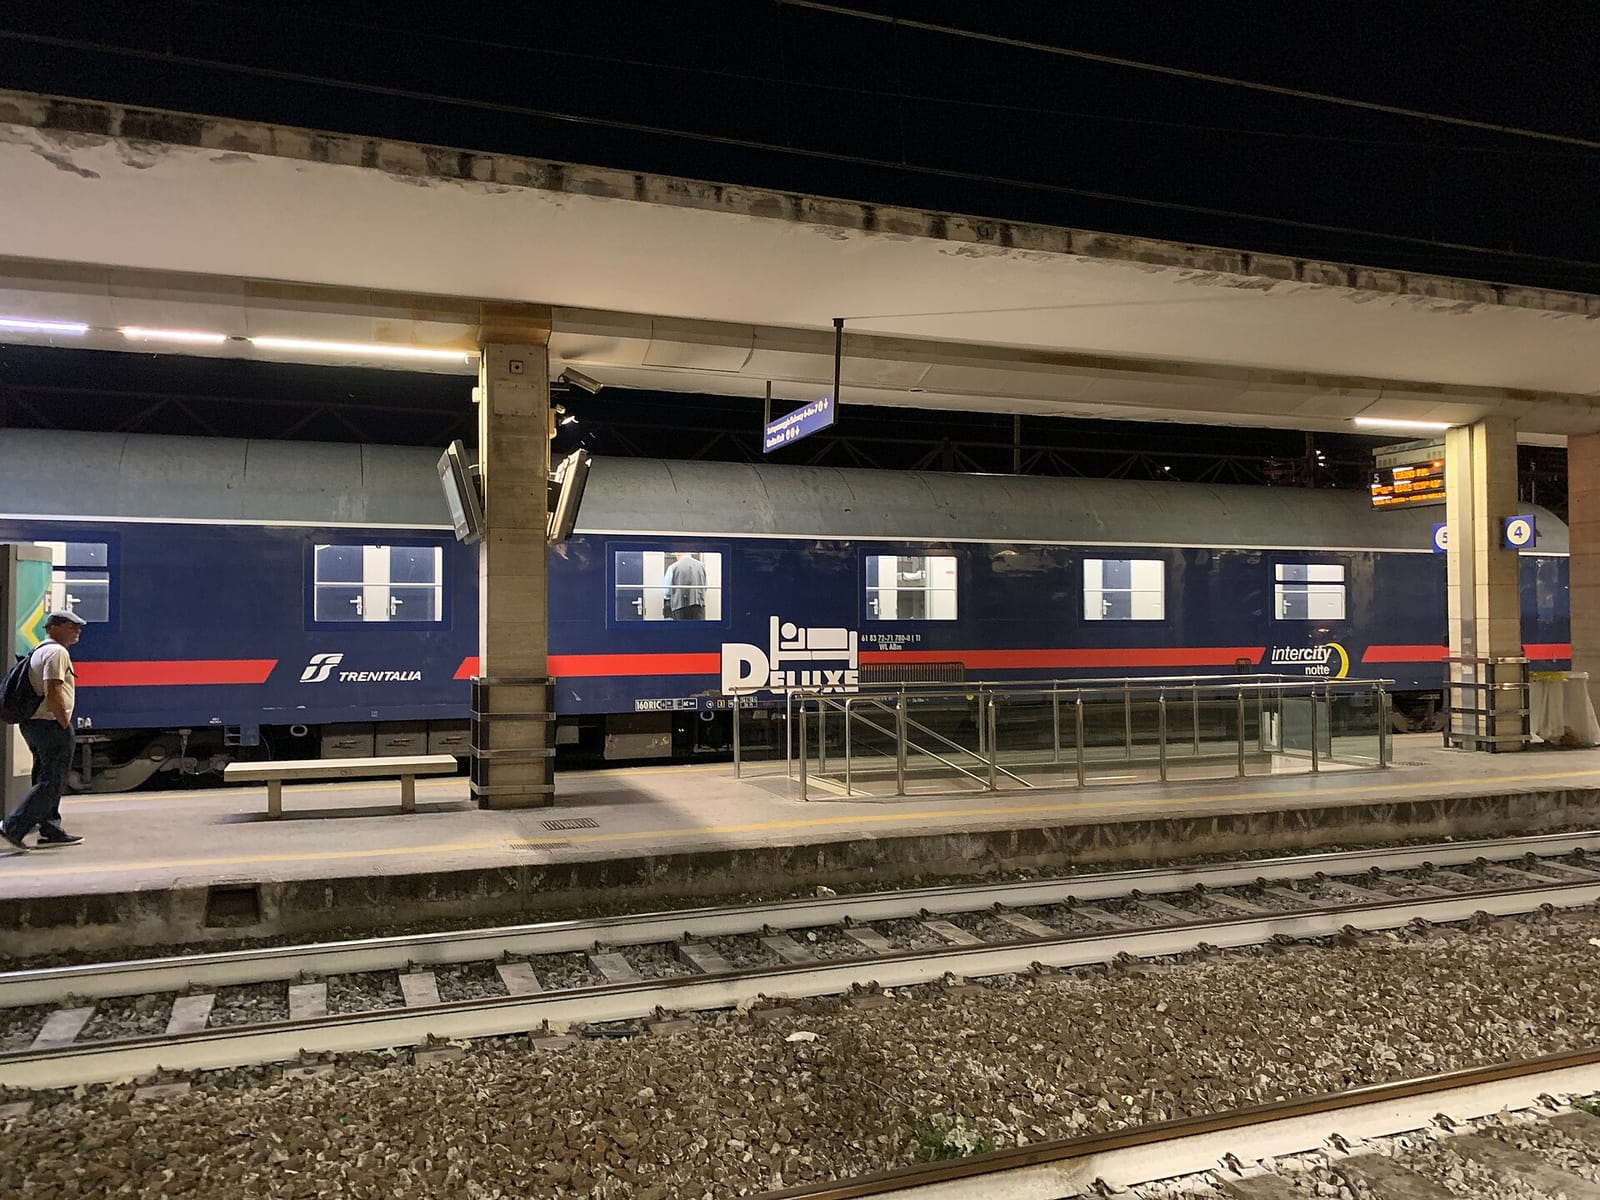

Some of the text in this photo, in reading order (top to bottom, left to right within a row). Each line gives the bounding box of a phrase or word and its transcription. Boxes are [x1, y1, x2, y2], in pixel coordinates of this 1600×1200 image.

[1373, 473, 1380, 483] 5
[1513, 526, 1523, 538] 4
[1271, 645, 1332, 662] intercity
[1305, 665, 1330, 675] notte
[338, 670, 422, 683] TRENITALIA
